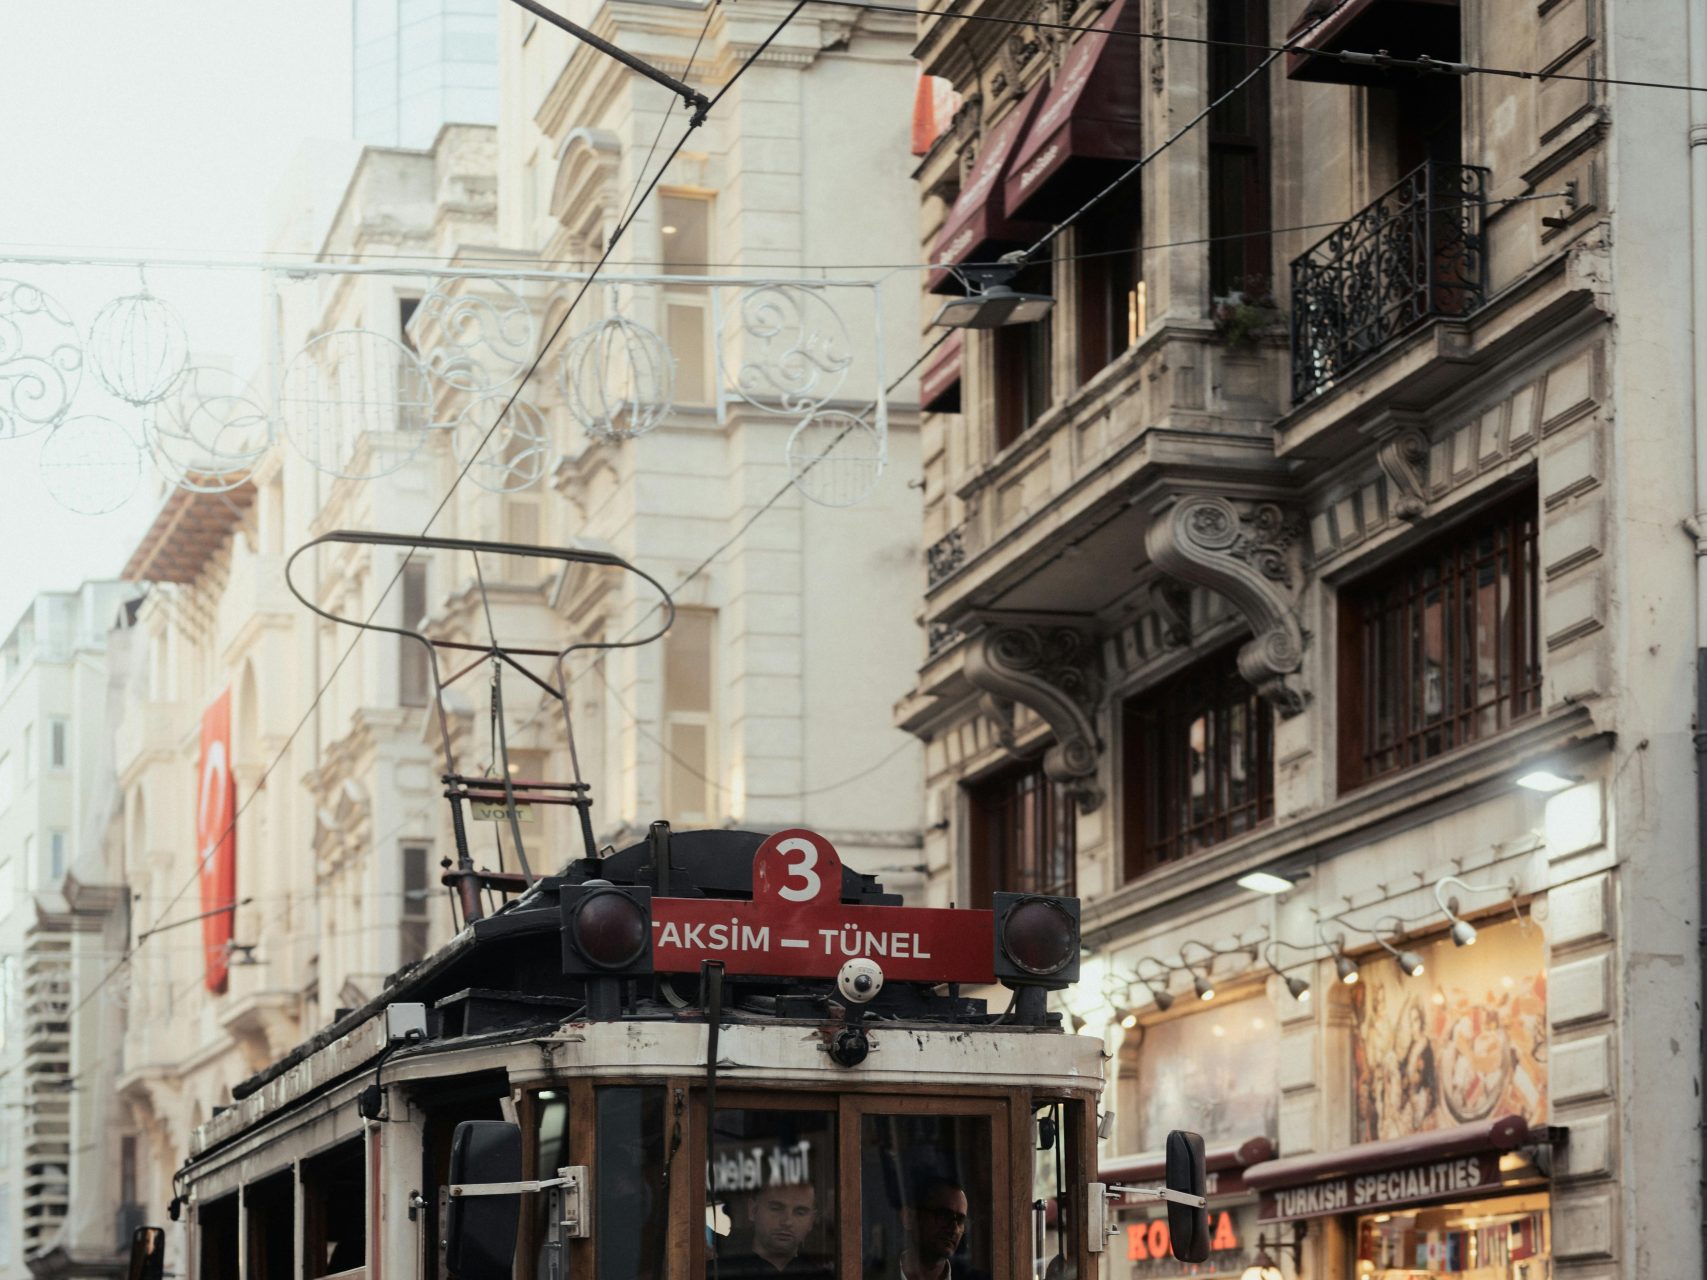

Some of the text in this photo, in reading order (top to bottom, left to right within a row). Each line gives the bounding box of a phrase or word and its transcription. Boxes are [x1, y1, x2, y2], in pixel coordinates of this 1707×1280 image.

[776, 836, 822, 902] 3
[652, 917, 770, 952] AKSİM
[818, 923, 931, 959] TÜNEL
[1274, 1157, 1482, 1218] TURKISH SPECIALITIES
[1126, 1211, 1237, 1261] KOA
